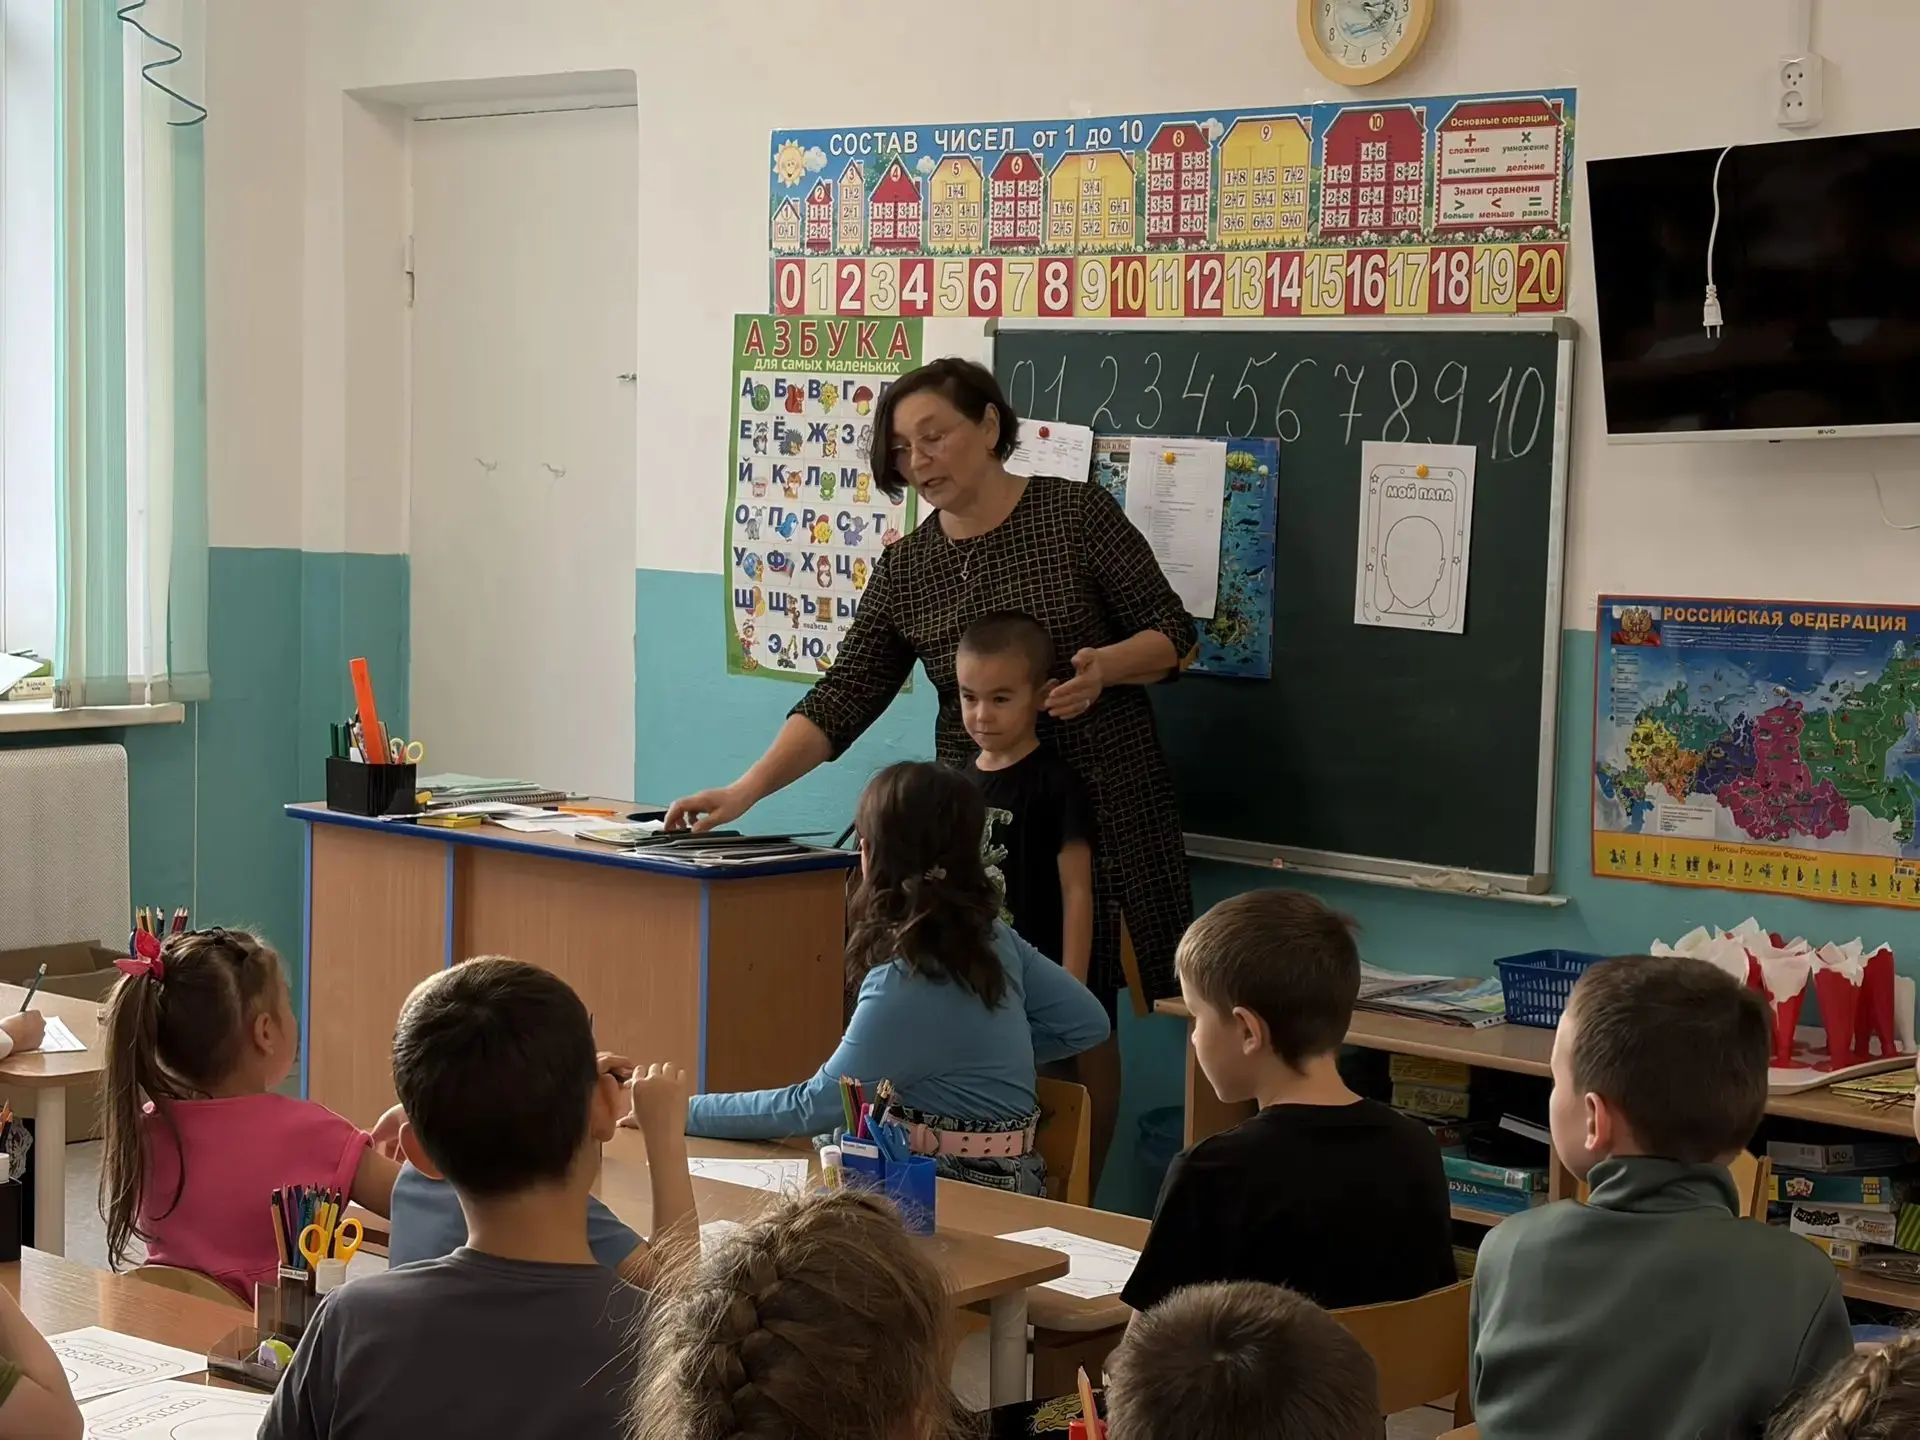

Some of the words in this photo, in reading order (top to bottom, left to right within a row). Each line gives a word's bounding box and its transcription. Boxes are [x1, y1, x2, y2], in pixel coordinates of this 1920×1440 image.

[1325, 4, 1330, 16] 9
[1403, 0, 1409, 12] 3
[1330, 28, 1334, 41] 8
[1396, 24, 1402, 36] 4
[1342, 45, 1348, 57] 7
[1362, 49, 1367, 62] 6
[1381, 43, 1387, 55] 5
[1373, 116, 1381, 129] 10
[1451, 117, 1500, 126] Основные
[1502, 115, 1549, 124] операции
[830, 132, 918, 156] СОСТАВ
[935, 128, 1014, 152] ЧИСЕЛ
[1033, 131, 1056, 148] от
[1065, 125, 1074, 146] 1
[1086, 128, 1111, 149] до
[1120, 120, 1143, 143] 10
[1177, 133, 1181, 145] 8
[1263, 126, 1269, 139] 9
[1503, 144, 1549, 154] умножение
[954, 163, 959, 175] 5
[1014, 159, 1019, 171] 6
[1448, 166, 1496, 175] вычитание
[1506, 164, 1545, 172] деление
[849, 168, 854, 180] 3
[892, 166, 898, 178] 4
[817, 188, 822, 200] 2
[1454, 187, 1483, 195] Знаки
[1486, 186, 1539, 195] сравнения
[1522, 209, 1549, 218] равно
[780, 263, 801, 309] 0
[812, 263, 827, 309] 1
[840, 263, 861, 310] 2
[870, 263, 896, 310] 3
[902, 263, 928, 310] 4
[940, 263, 964, 309] 5
[973, 263, 996, 311] 6
[1009, 263, 1034, 311] 7
[1045, 262, 1068, 311] 8
[1081, 260, 1106, 310] 9
[1111, 260, 1146, 310] 10
[1150, 260, 1179, 311] 11
[1187, 259, 1221, 309] 12
[1227, 257, 1263, 309] 13
[1267, 256, 1300, 308] 14
[1305, 255, 1344, 308] 15
[1348, 254, 1385, 306] 16
[1389, 253, 1428, 306] 17
[1432, 252, 1469, 305] 18
[1474, 249, 1513, 305] 19
[1518, 249, 1562, 304] 20
[743, 319, 911, 360] АЗБУКА
[754, 359, 777, 370] для
[781, 361, 822, 370] самых
[826, 361, 900, 372] маленьких
[742, 378, 754, 397] А
[775, 379, 787, 399] Б
[808, 379, 820, 399] В
[843, 381, 854, 400] Г
[1010, 360, 1035, 419] 0
[1045, 354, 1067, 420] 1
[1091, 356, 1121, 429] 2
[1136, 352, 1162, 429] 3
[1182, 352, 1214, 433] 4
[1226, 352, 1277, 437] 5
[1276, 358, 1317, 442] 6
[1334, 364, 1365, 445] 7
[1382, 360, 1418, 442] 8
[1432, 361, 1468, 445] 9
[1488, 366, 1545, 459] 10
[740, 421, 752, 439] Е
[774, 416, 785, 440] Ё
[807, 423, 828, 442] Ж
[841, 424, 854, 444] З
[739, 457, 753, 482] Й
[772, 465, 786, 483] К
[805, 467, 820, 485] Л
[840, 468, 857, 488] М
[1386, 483, 1416, 499] МОЙ
[1418, 487, 1454, 502] ПАПА
[736, 505, 749, 524] О
[768, 507, 783, 526] П
[802, 509, 815, 528] Р
[837, 511, 850, 531] С
[873, 514, 885, 533] Т
[733, 547, 746, 566] У
[767, 550, 785, 570] Ф
[801, 552, 815, 572] Х
[836, 555, 851, 579] Ц
[735, 589, 754, 608] Ш
[769, 591, 788, 616] Щ
[801, 595, 815, 613] Ъ
[1663, 606, 1784, 625] РОССИЙСКАЯ
[1790, 610, 1907, 631] ФЕДЕРАЦИЯ
[768, 634, 782, 653] Э
[802, 637, 823, 658] Ю
